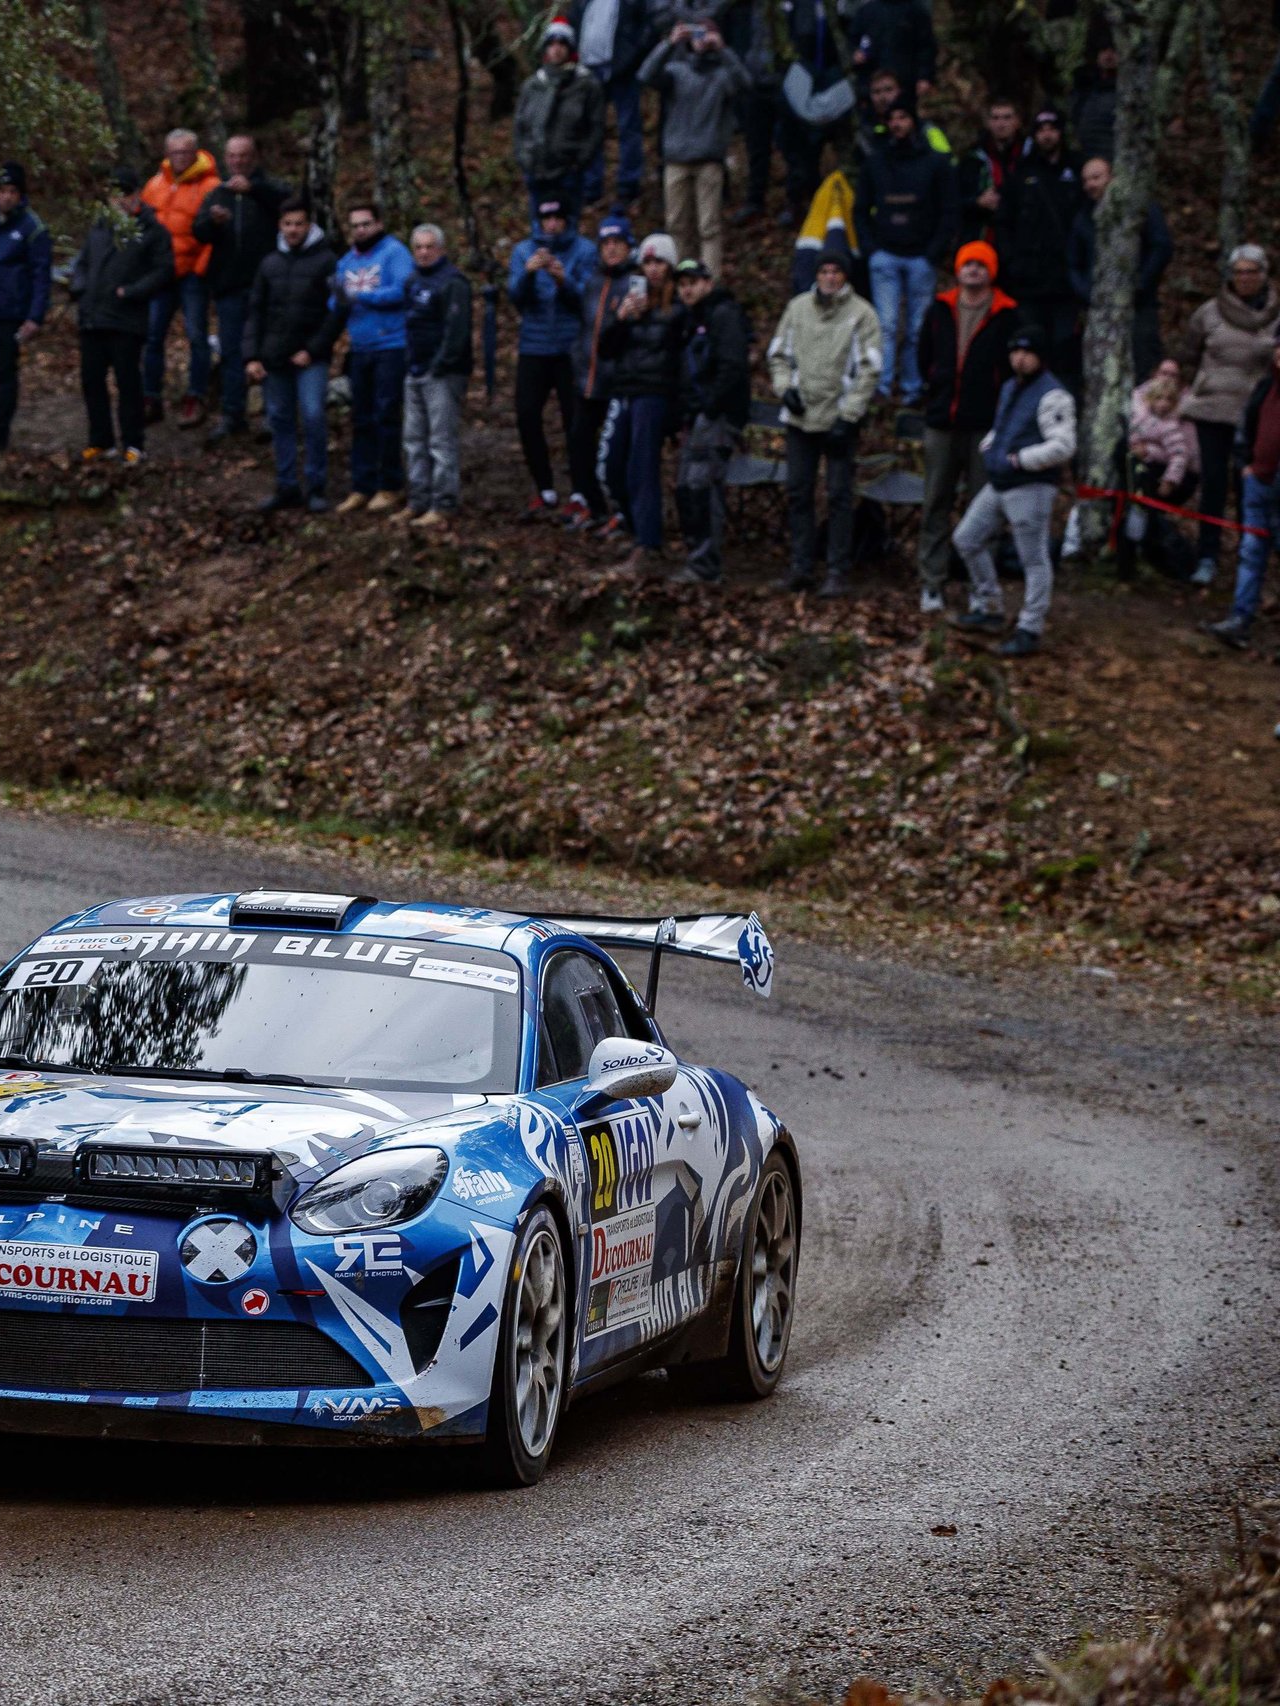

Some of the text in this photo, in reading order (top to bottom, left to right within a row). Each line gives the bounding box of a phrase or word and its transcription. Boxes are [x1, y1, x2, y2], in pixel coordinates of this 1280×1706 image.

[290, 906, 337, 914] EMOTION
[125, 931, 426, 966] RHIN BLUE
[23, 960, 78, 987] 20
[600, 1055, 649, 1071] SOLIDO
[590, 1132, 616, 1210] 20
[616, 1116, 655, 1210] IGOL
[463, 1169, 512, 1198] rally
[58, 1249, 70, 1259] et
[73, 1250, 152, 1267] LOGISTIQUE
[371, 1270, 403, 1278] EMOTION
